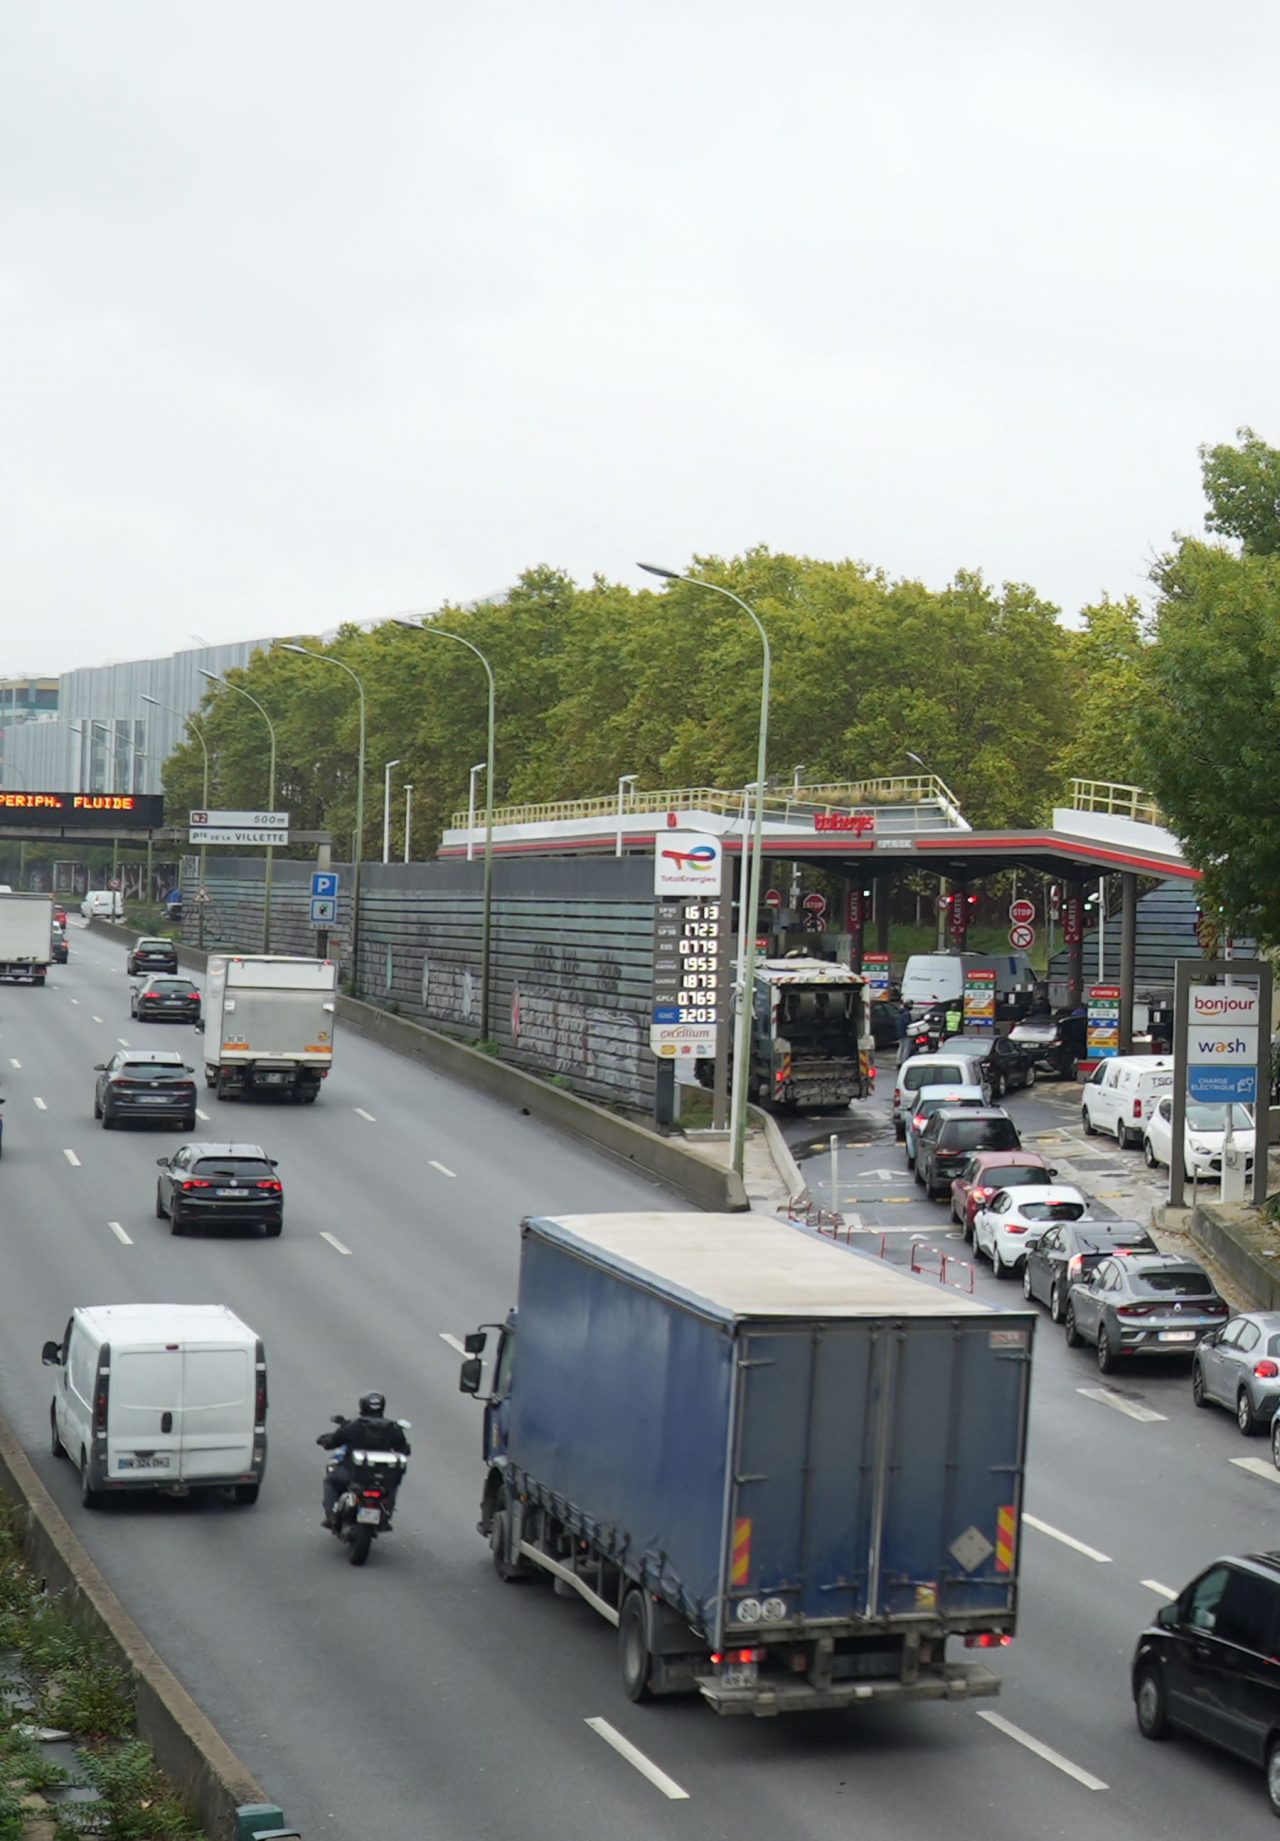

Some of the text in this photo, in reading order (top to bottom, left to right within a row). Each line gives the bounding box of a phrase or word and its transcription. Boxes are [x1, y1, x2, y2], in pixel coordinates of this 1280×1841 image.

[73, 796, 134, 810] FLUIDE
[235, 833, 285, 842] VILLETTE
[660, 874, 716, 884] TotalEnergies
[1012, 908, 1032, 916] STOP
[1194, 995, 1255, 1013] bonjour
[660, 1027, 709, 1038] excellium
[1198, 1038, 1246, 1053] wash
[1151, 1076, 1173, 1086] TSG
